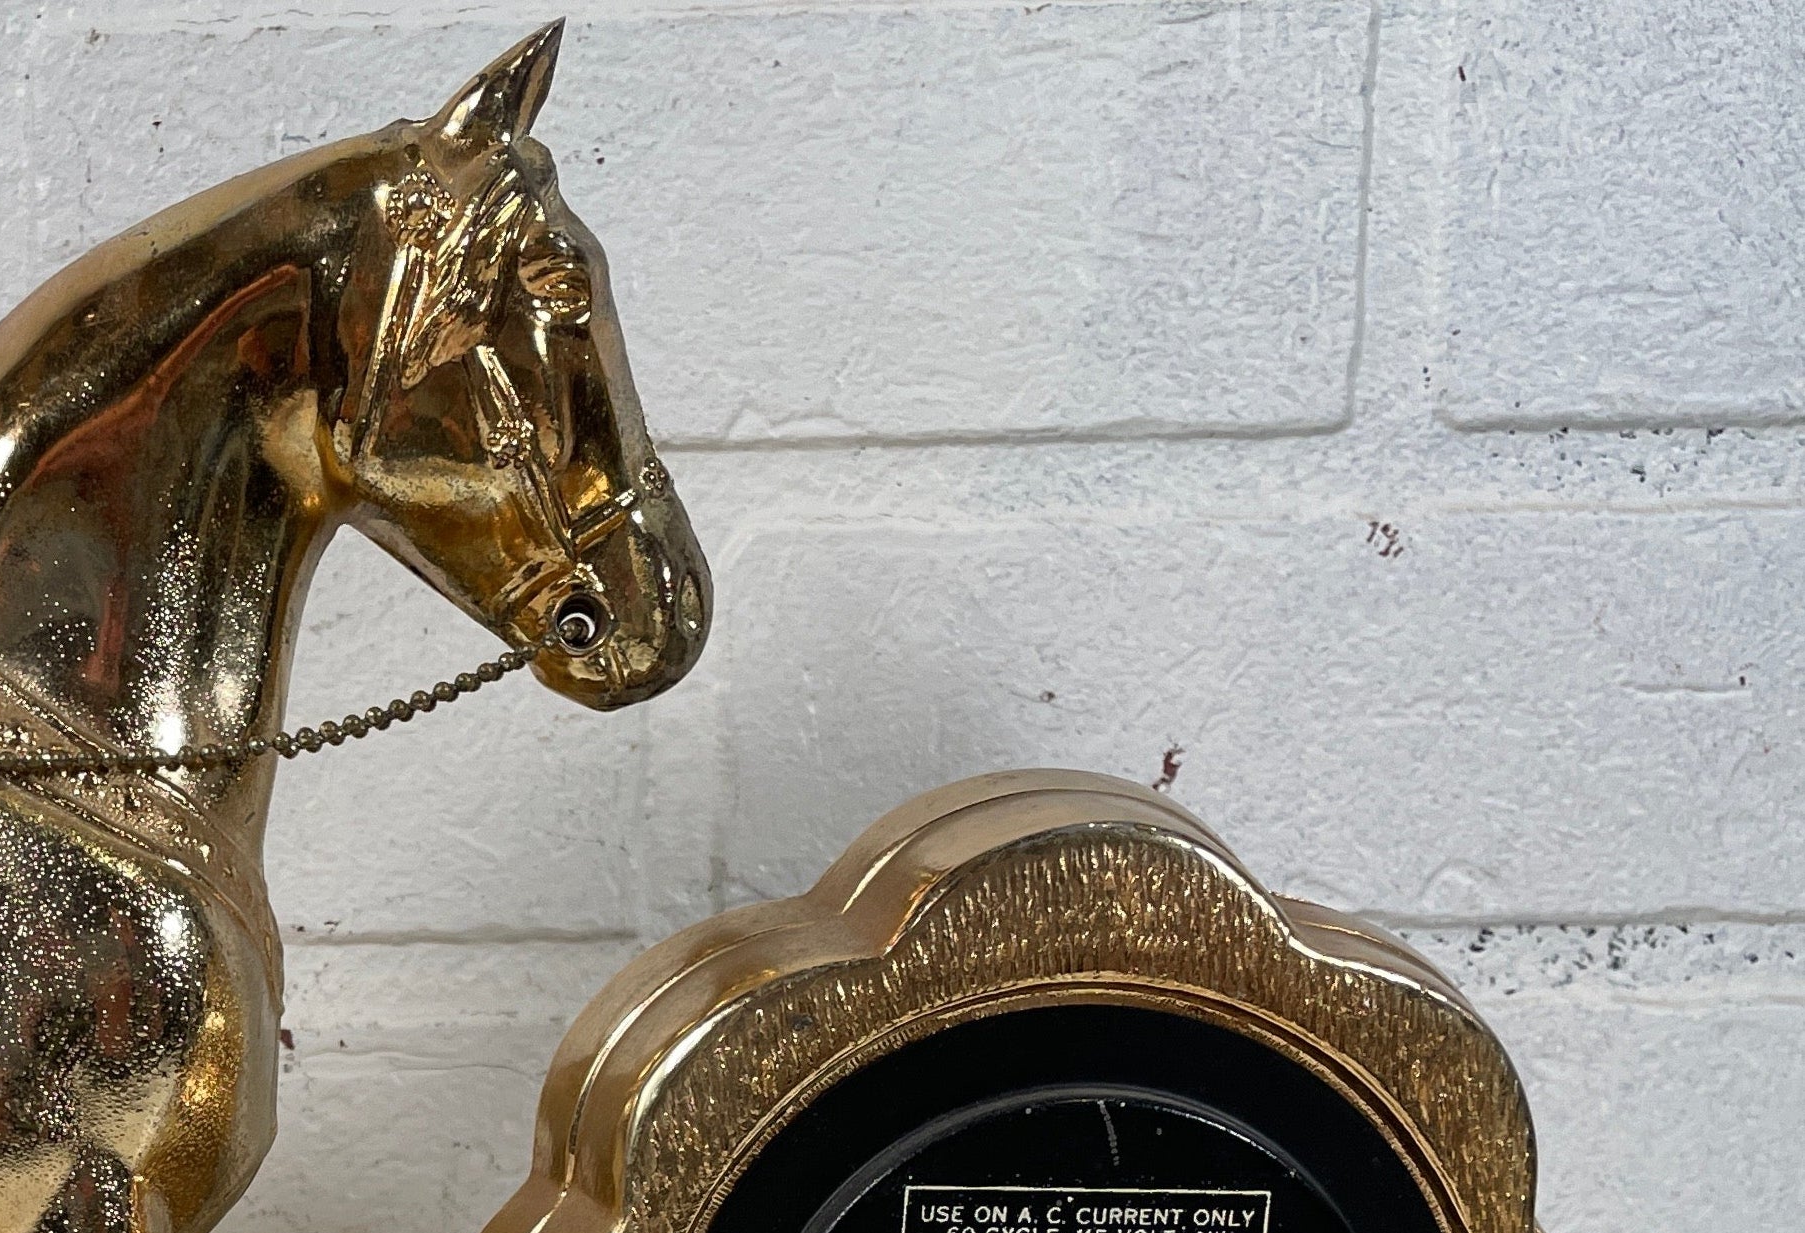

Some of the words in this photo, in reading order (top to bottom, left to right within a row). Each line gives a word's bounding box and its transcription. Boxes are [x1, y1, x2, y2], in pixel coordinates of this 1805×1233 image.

[922, 1205, 964, 1224] USE
[974, 1206, 1007, 1222] ON
[1076, 1208, 1183, 1225] CURRENT
[1194, 1209, 1255, 1227] ONLY
